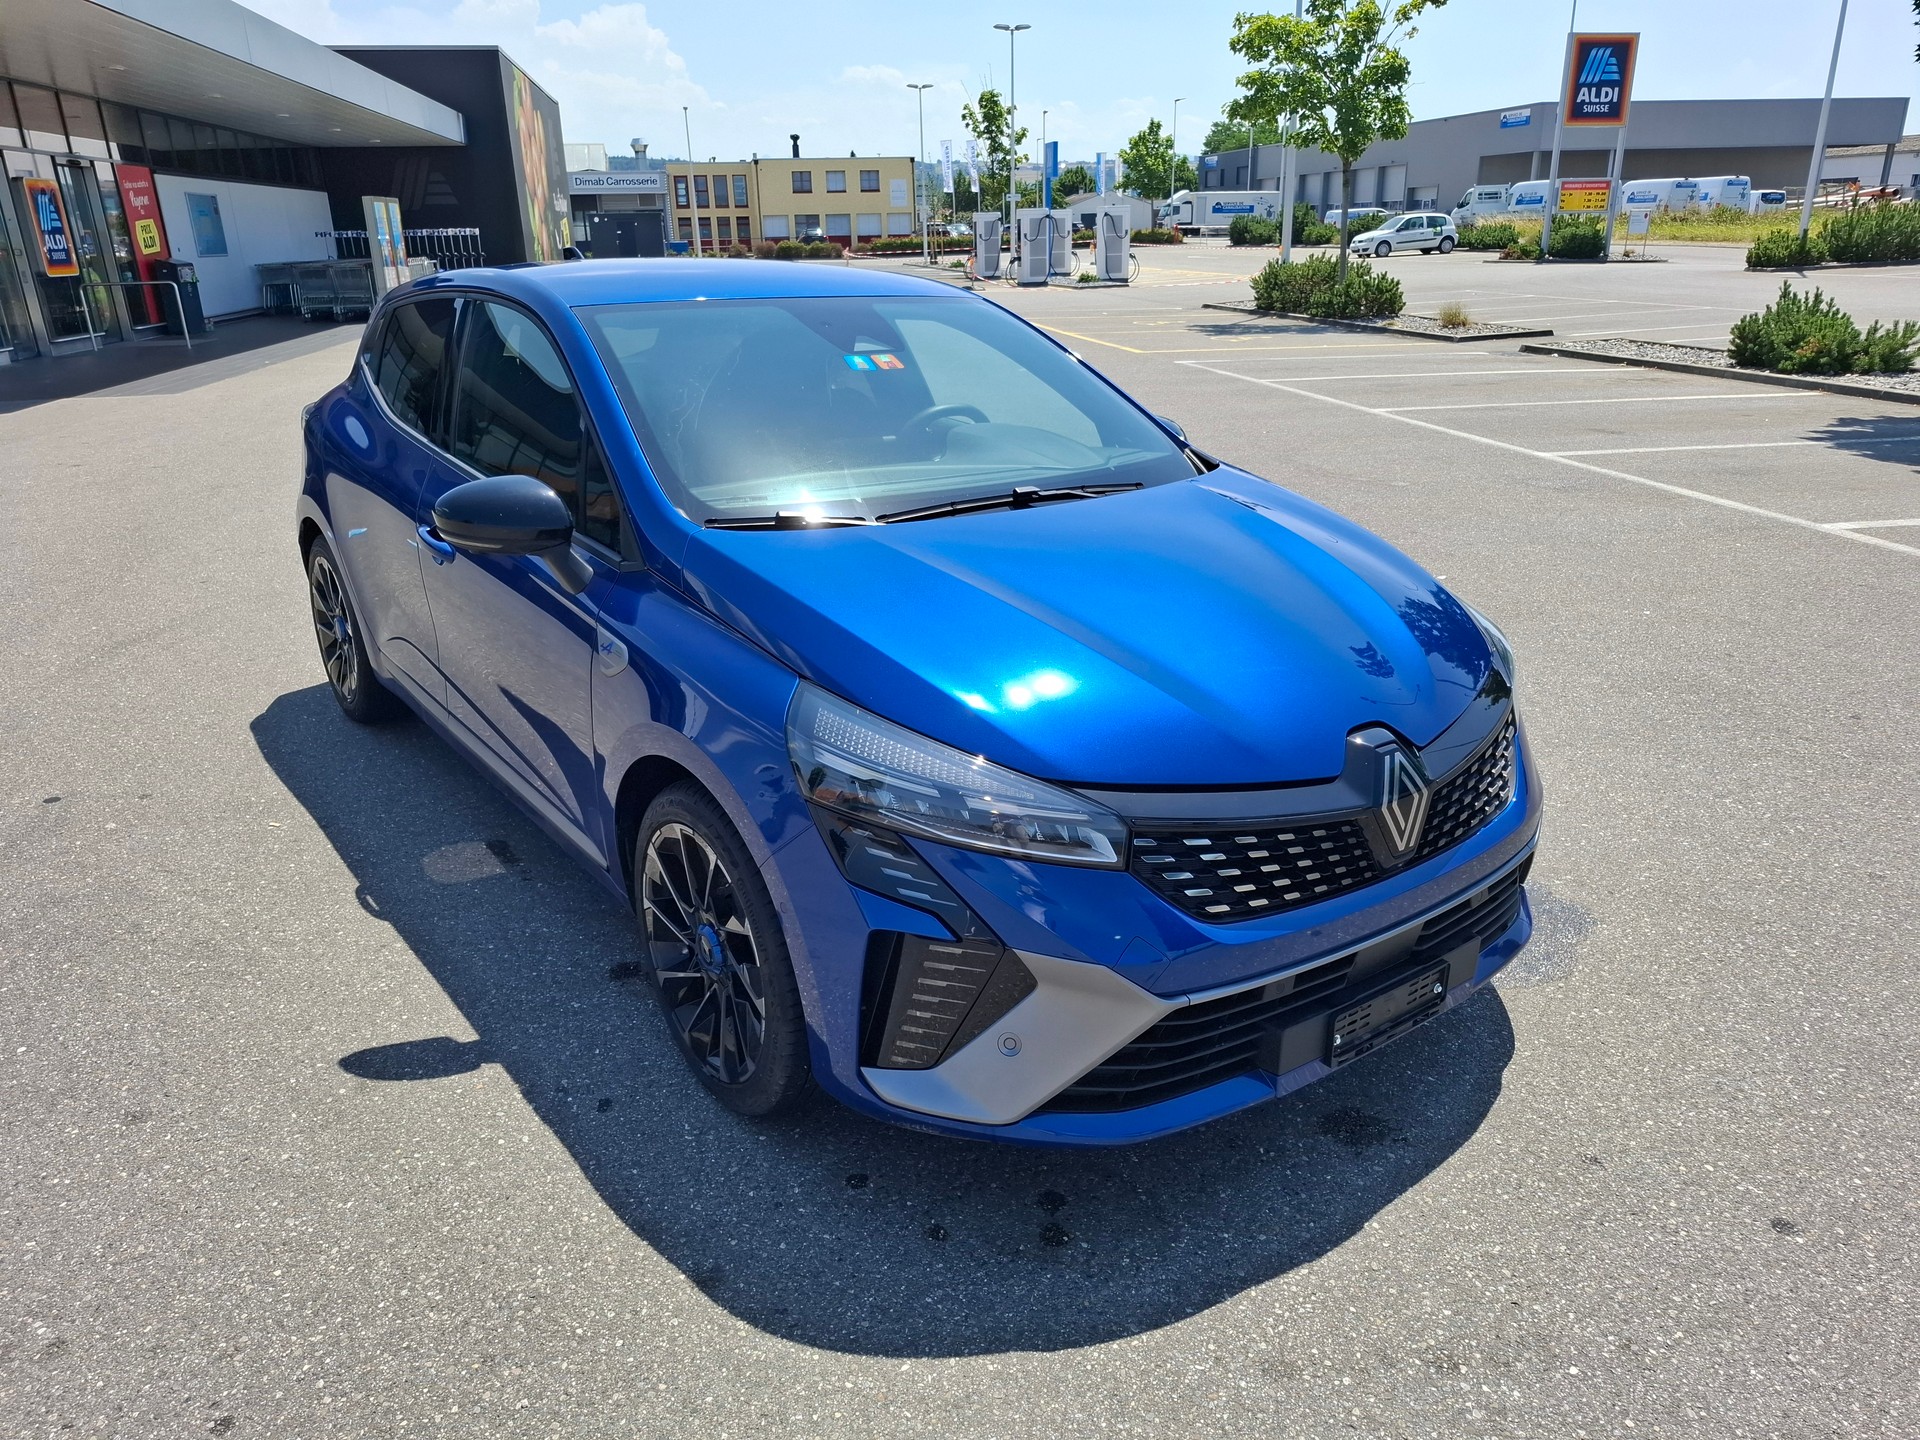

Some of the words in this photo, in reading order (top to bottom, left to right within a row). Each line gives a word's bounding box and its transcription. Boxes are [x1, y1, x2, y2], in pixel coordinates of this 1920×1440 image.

[1576, 86, 1620, 103] ALDI
[1582, 104, 1610, 113] SUISSE
[574, 177, 604, 186] Dimab
[606, 176, 658, 186] Carrosserie
[140, 223, 152, 235] PRIX
[44, 234, 68, 250] ALDI
[142, 235, 157, 250] ALDI
